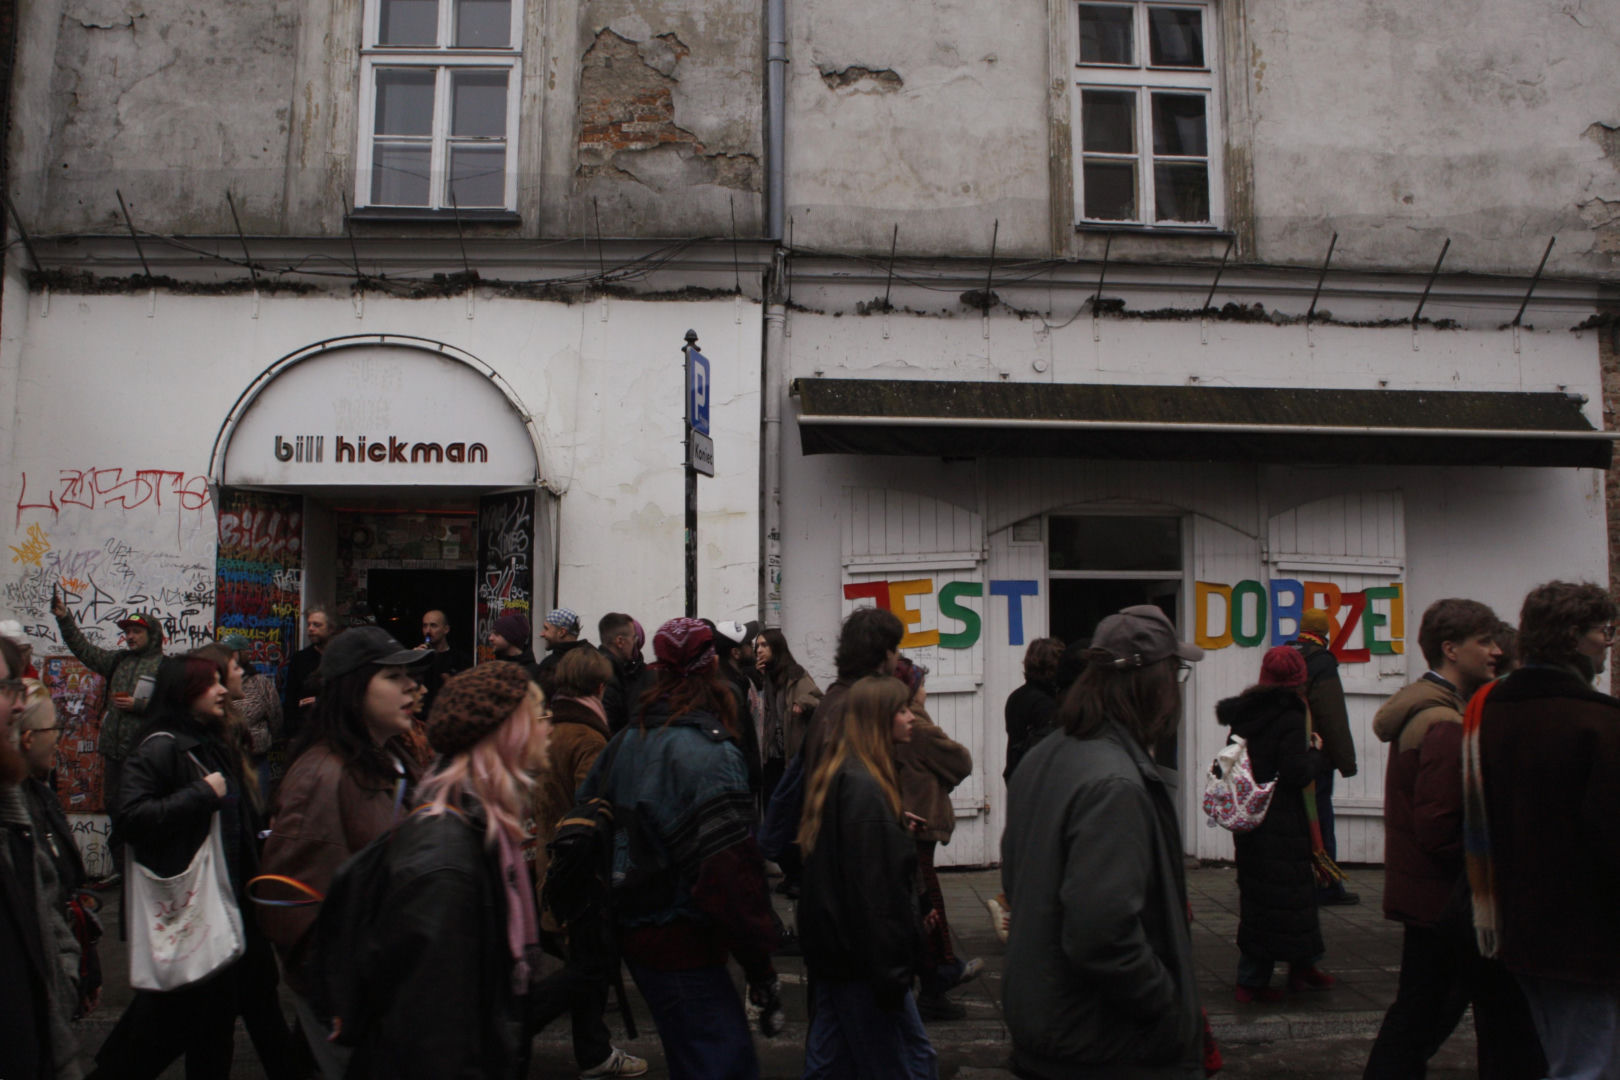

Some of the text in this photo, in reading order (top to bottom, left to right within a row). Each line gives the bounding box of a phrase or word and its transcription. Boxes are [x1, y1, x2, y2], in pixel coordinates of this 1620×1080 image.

[694, 361, 706, 421] P
[275, 435, 489, 463] bill hickman
[694, 442, 714, 465] Koniec
[1194, 578, 1405, 664] DOBRZE!
